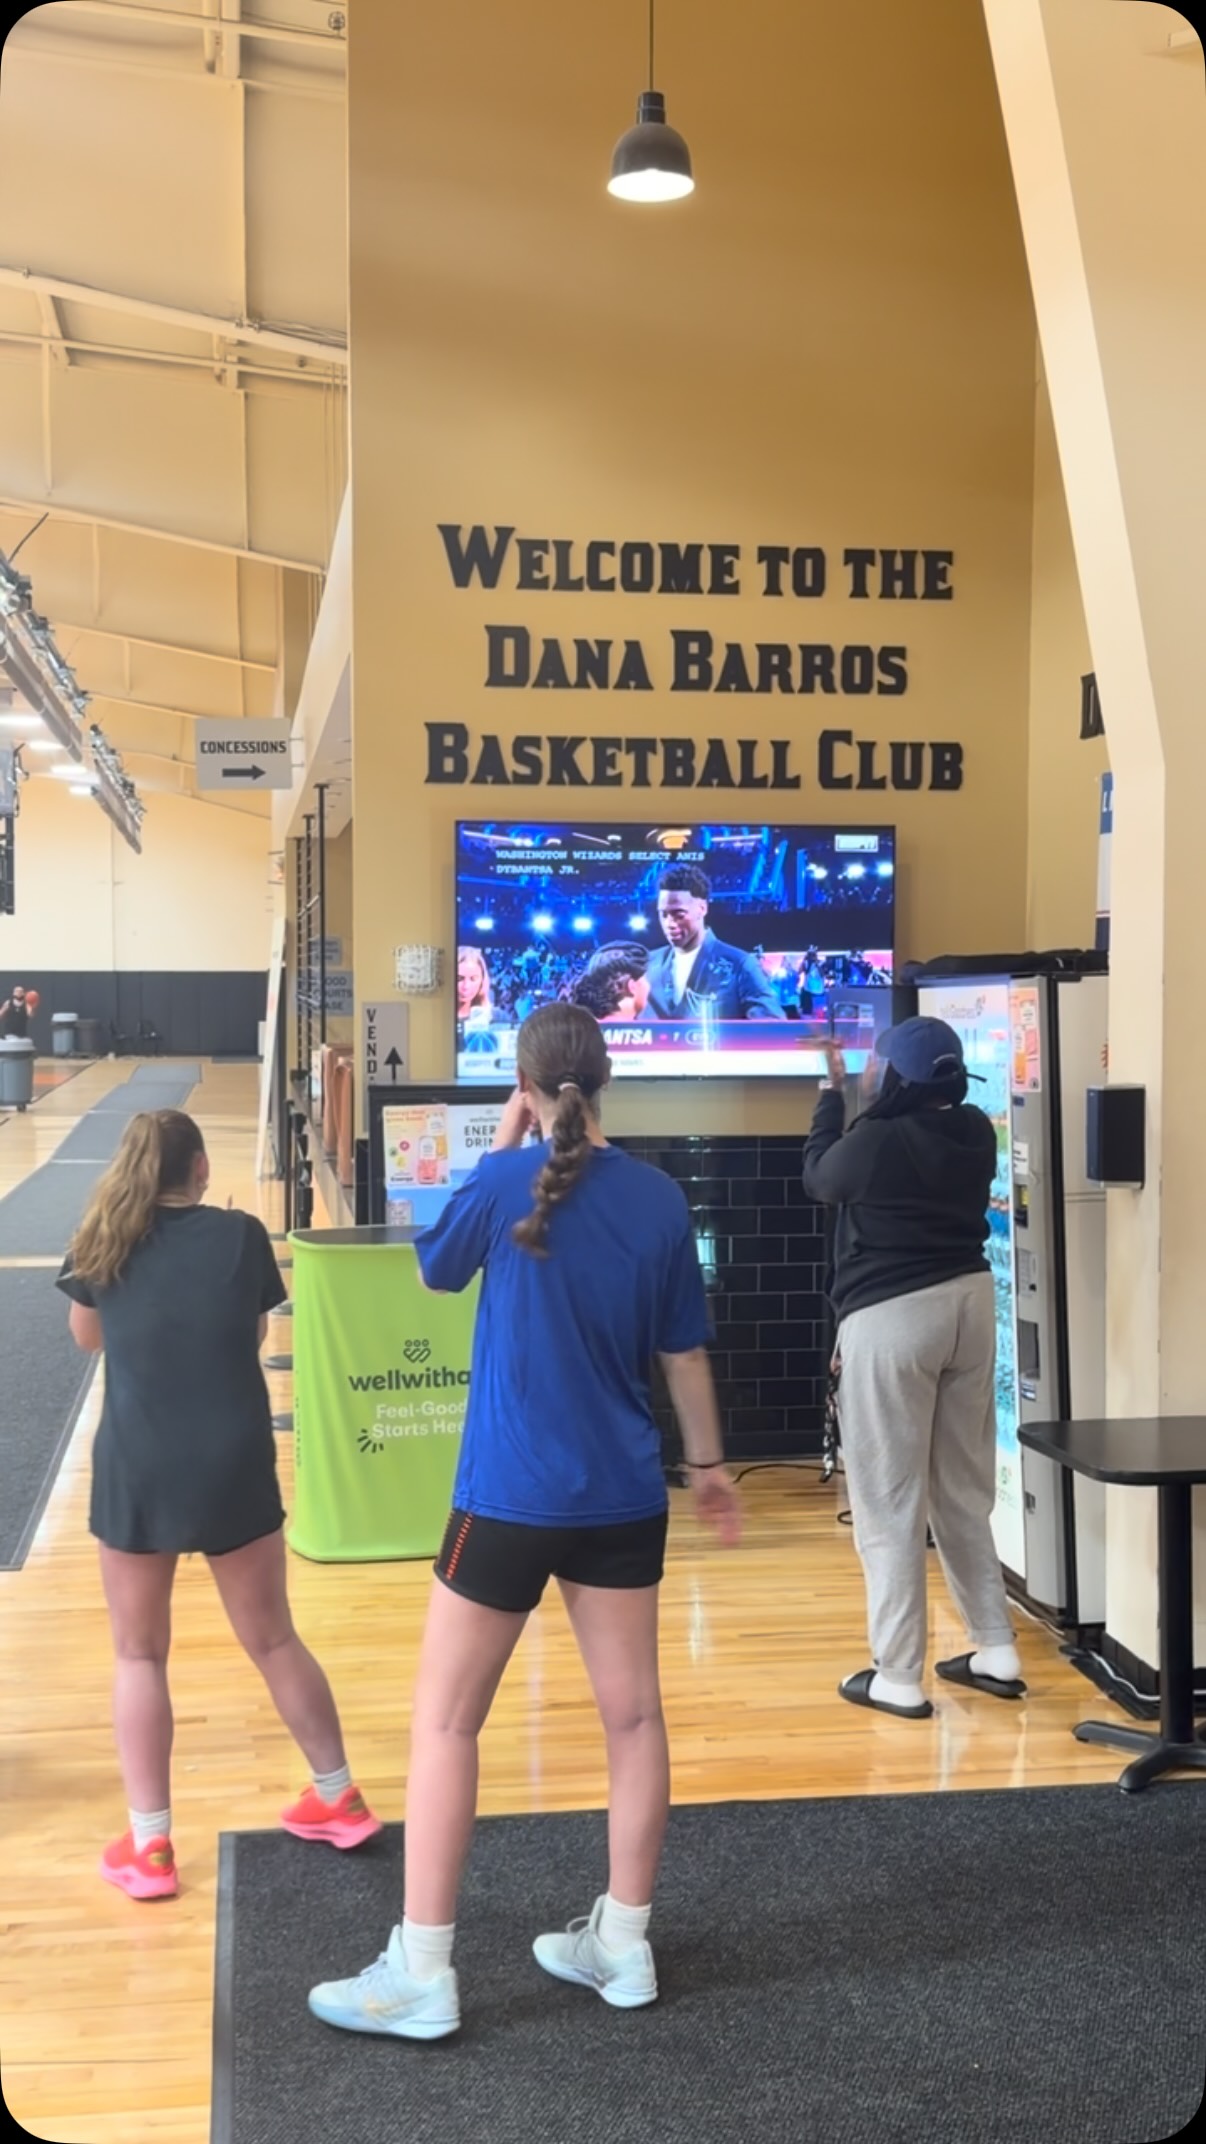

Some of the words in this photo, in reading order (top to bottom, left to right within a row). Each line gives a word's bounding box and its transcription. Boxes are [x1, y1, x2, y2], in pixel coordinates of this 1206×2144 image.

[437, 524, 741, 596] WELCOME
[757, 545, 826, 598] TO
[843, 548, 955, 600] THE
[484, 624, 655, 691] DANA
[670, 629, 908, 696] BARROS
[200, 741, 287, 754] CONCESSIONS
[424, 722, 801, 790] BASKETBALL
[817, 729, 964, 791] CLUB
[495, 850, 567, 860] WASHINGTON
[572, 851, 622, 861] WIZARDS
[628, 851, 671, 861] SELECT
[366, 1008, 377, 1081] VEND
[372, 1422, 428, 1439] Starts
